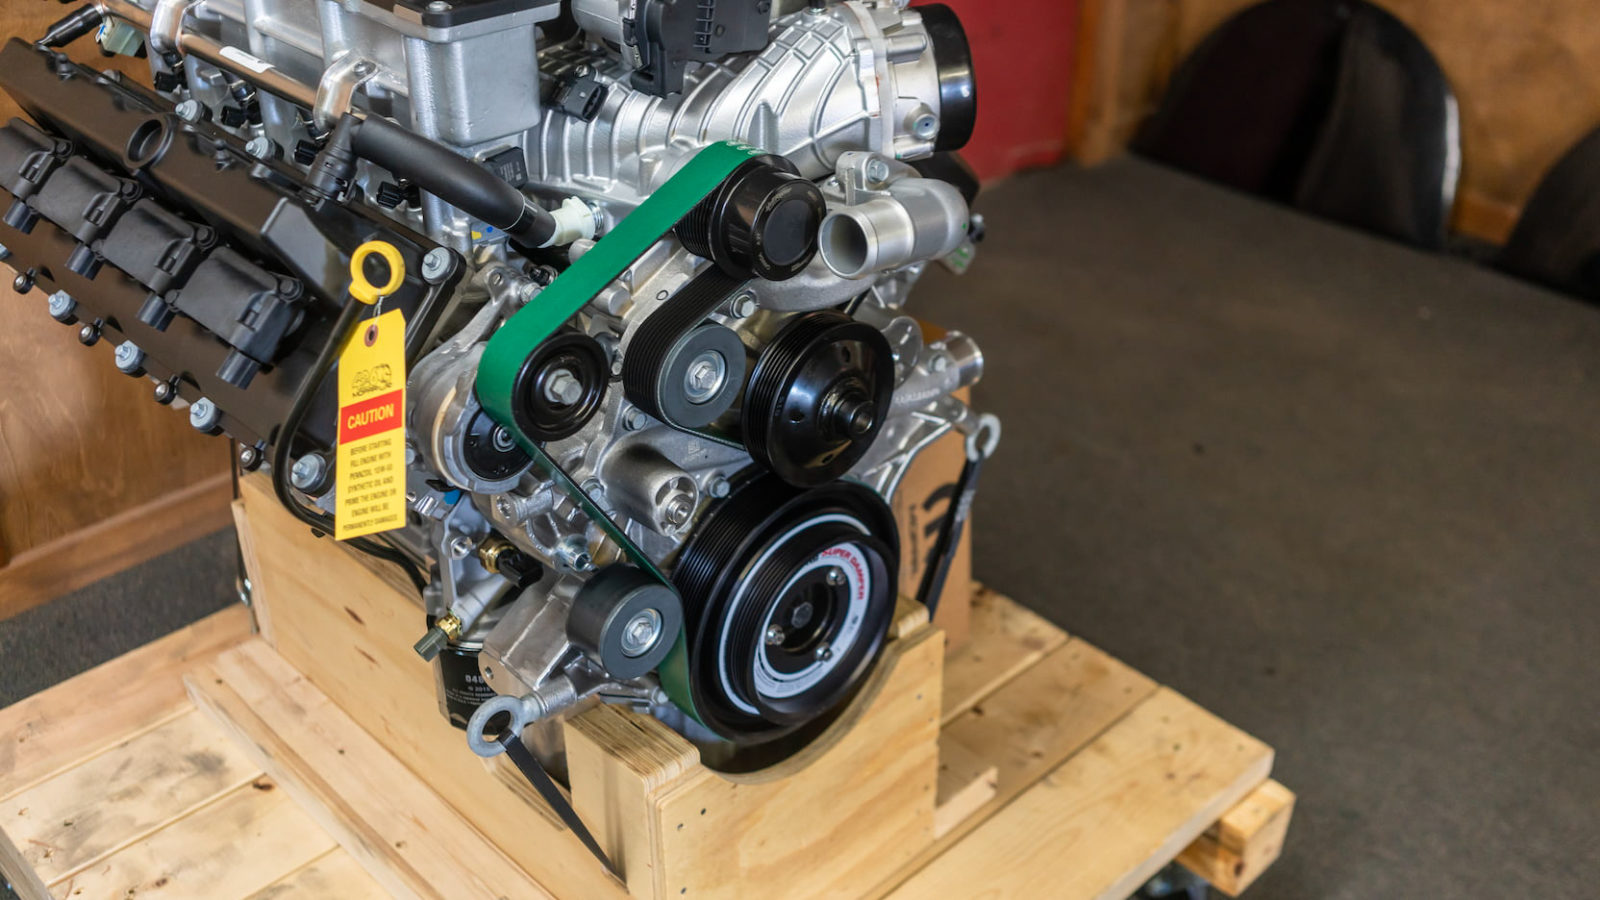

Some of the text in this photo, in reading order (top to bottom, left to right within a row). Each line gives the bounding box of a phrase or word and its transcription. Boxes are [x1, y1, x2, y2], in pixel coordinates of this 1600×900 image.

[347, 403, 395, 430] CAUTION
[368, 438, 392, 450] STARTING
[360, 454, 377, 466] ENGINE
[378, 451, 392, 460] WITH
[347, 480, 373, 493] SYNTHETIC
[382, 475, 394, 485] AND
[360, 494, 369, 502] THE
[370, 490, 388, 501] ENGINE
[351, 506, 369, 517] ENGINE
[382, 502, 389, 510] BE
[821, 547, 865, 600] SUPER DAMPER
